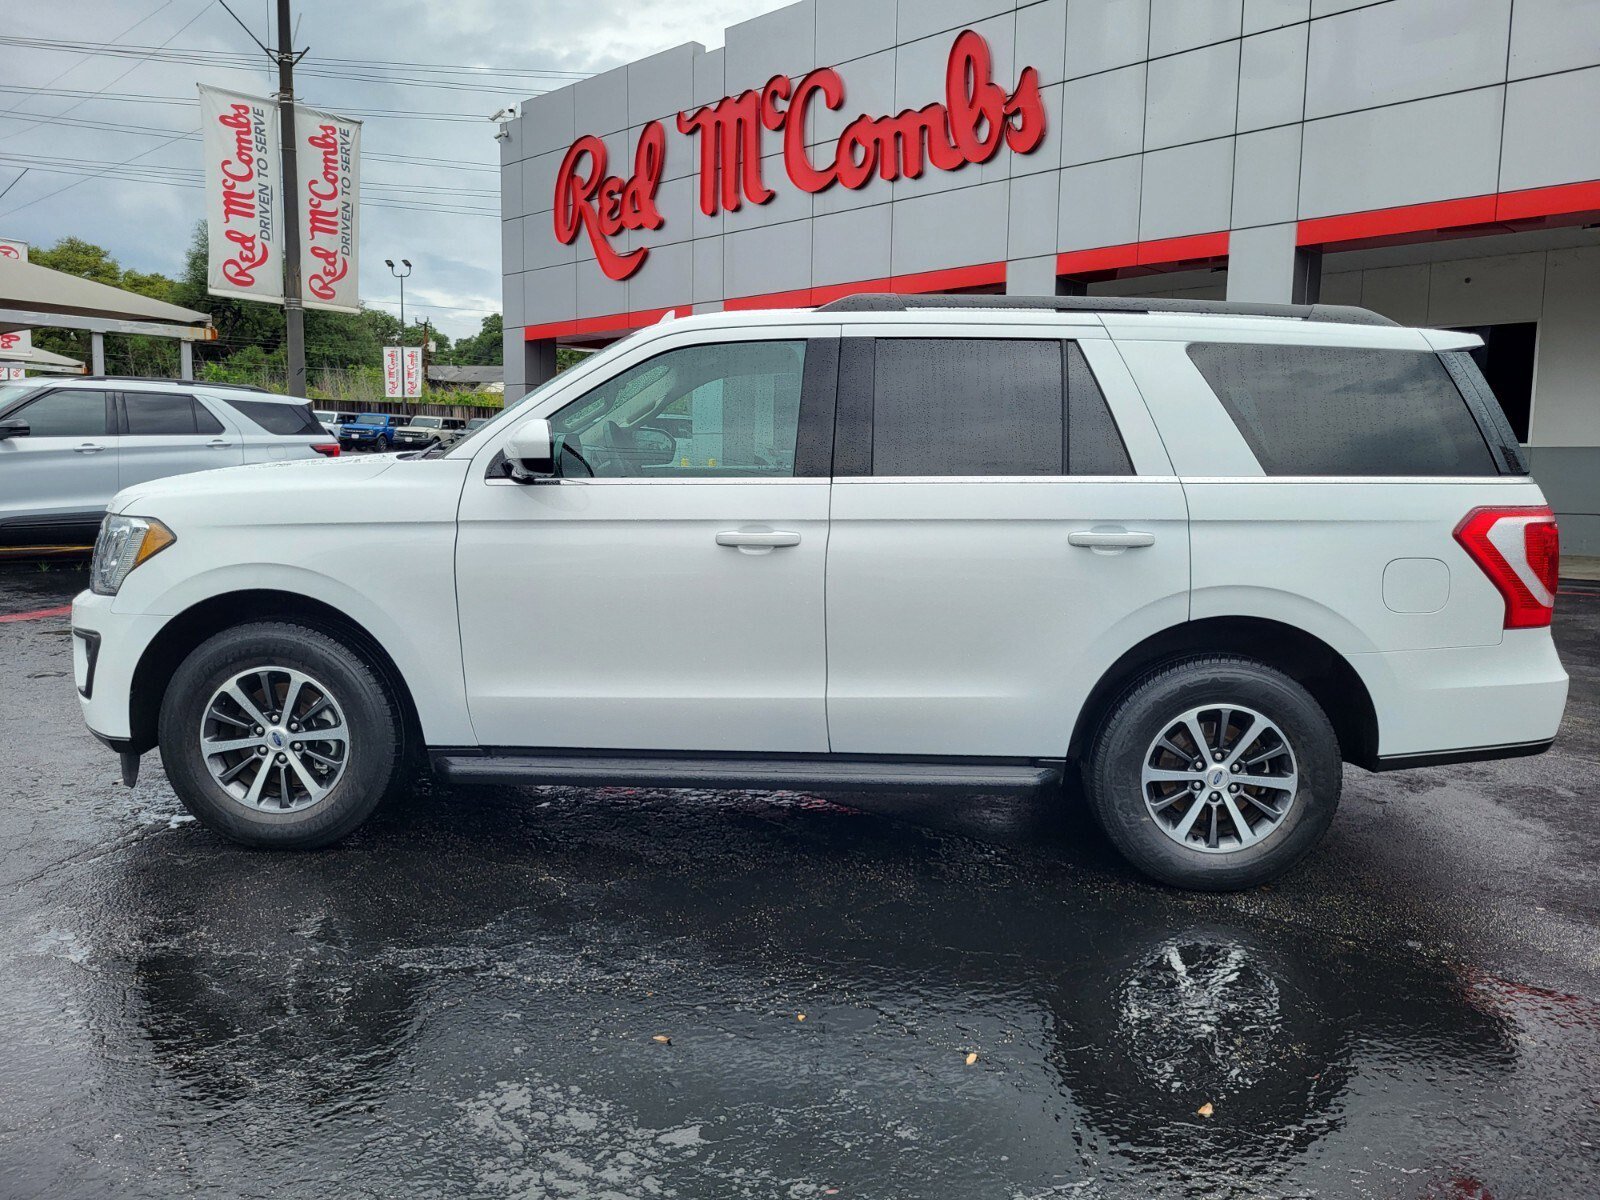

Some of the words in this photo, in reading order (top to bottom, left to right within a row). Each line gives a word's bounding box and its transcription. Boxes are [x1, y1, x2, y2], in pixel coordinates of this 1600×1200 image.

[252, 106, 267, 155] SERVE
[339, 128, 351, 172] SERVE
[554, 120, 665, 281] Red
[677, 29, 1048, 217] McCombs
[218, 103, 256, 224] McCombs
[257, 157, 269, 180] TO
[307, 124, 339, 241] McCombs
[341, 176, 351, 197] TO
[256, 185, 272, 242] DRIVEN
[339, 202, 351, 257] DRIVEN
[222, 229, 269, 287] Red
[308, 246, 348, 300] Red
